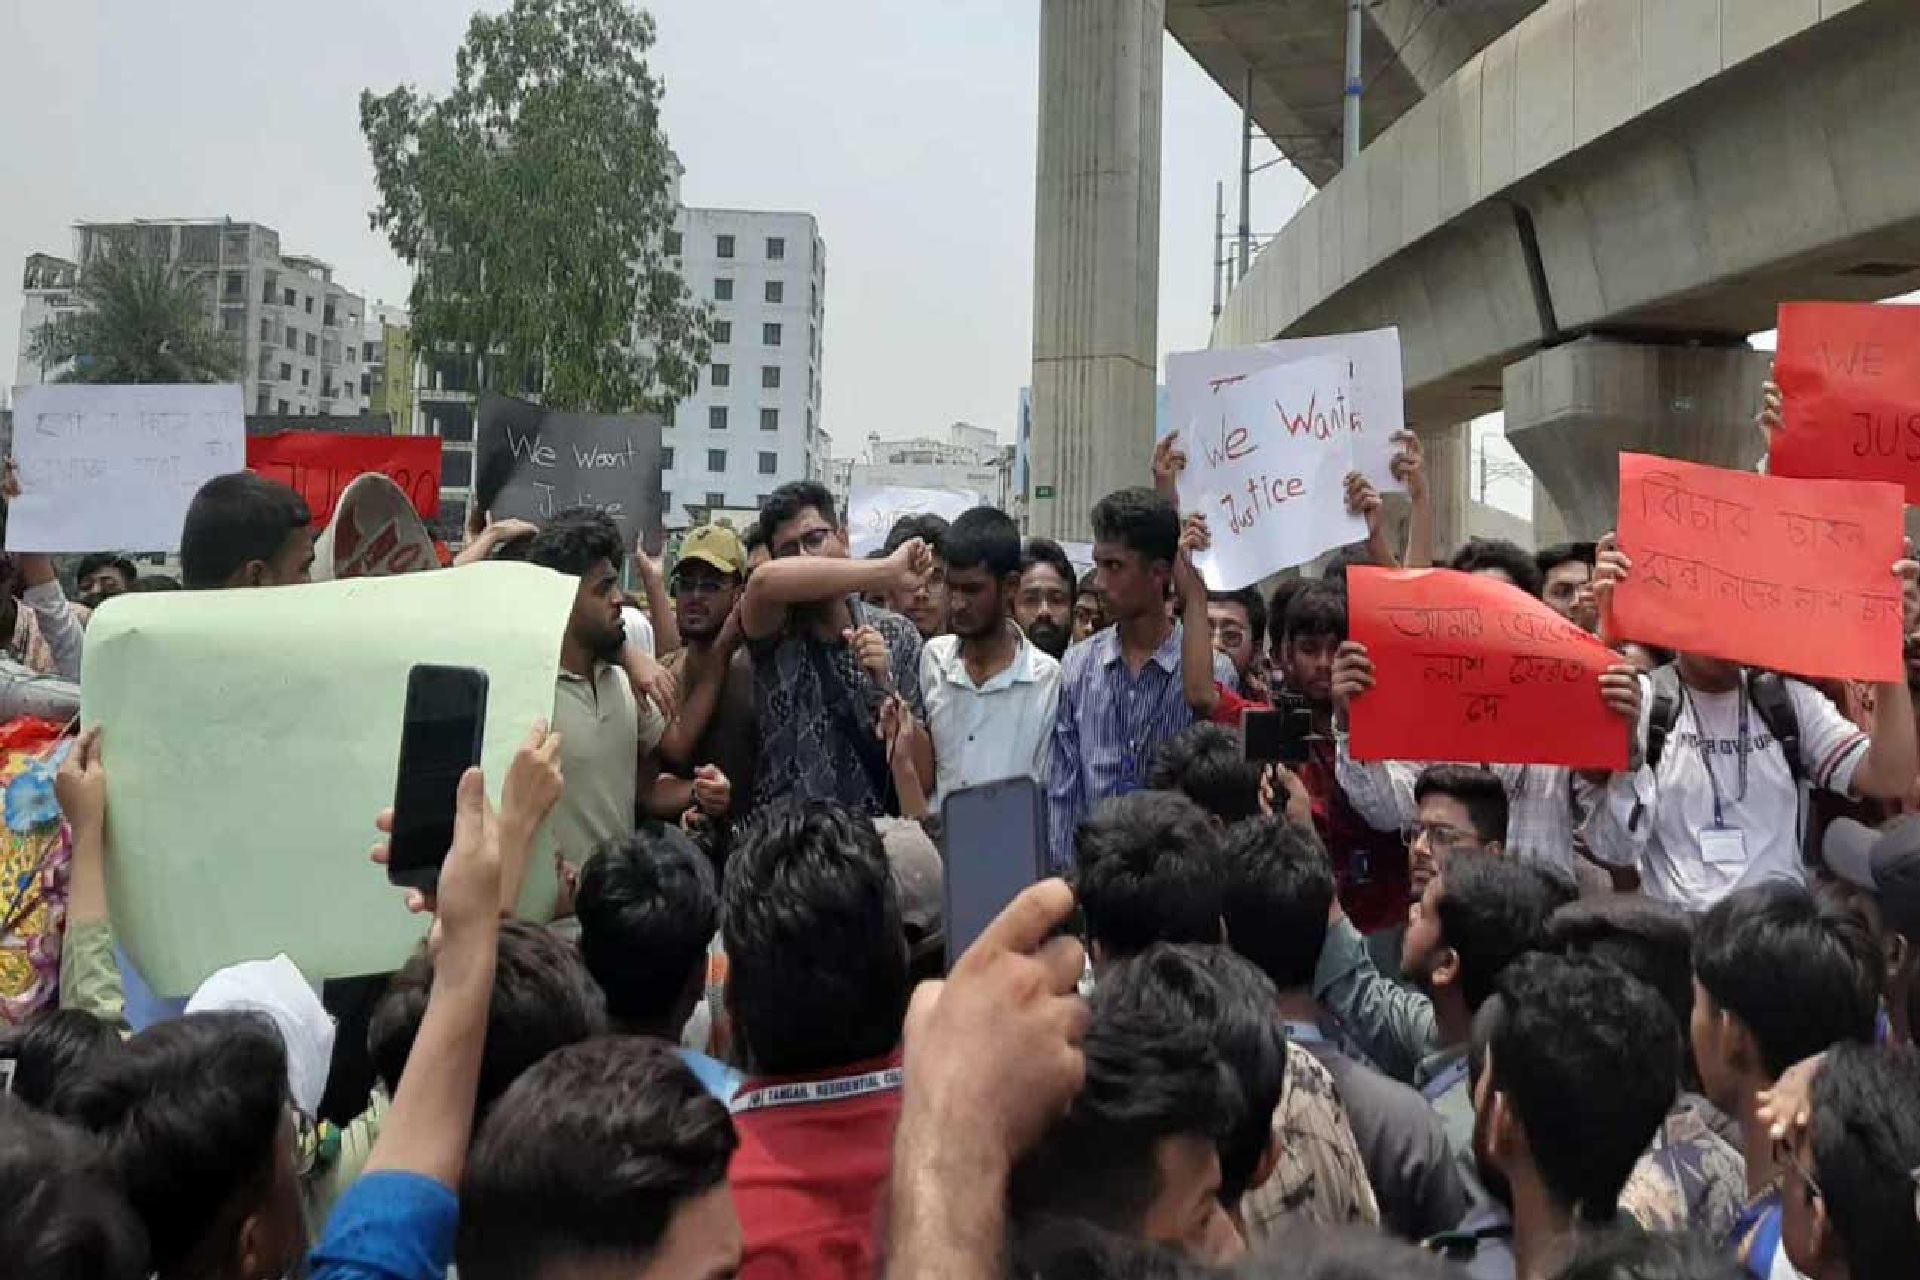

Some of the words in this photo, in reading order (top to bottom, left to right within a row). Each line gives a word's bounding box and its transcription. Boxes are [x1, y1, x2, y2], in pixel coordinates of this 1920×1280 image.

[1820, 341, 1884, 376] WE
[507, 424, 556, 466] We
[572, 435, 641, 470] Want
[1204, 414, 1258, 469] We
[1220, 475, 1306, 535] Justice
